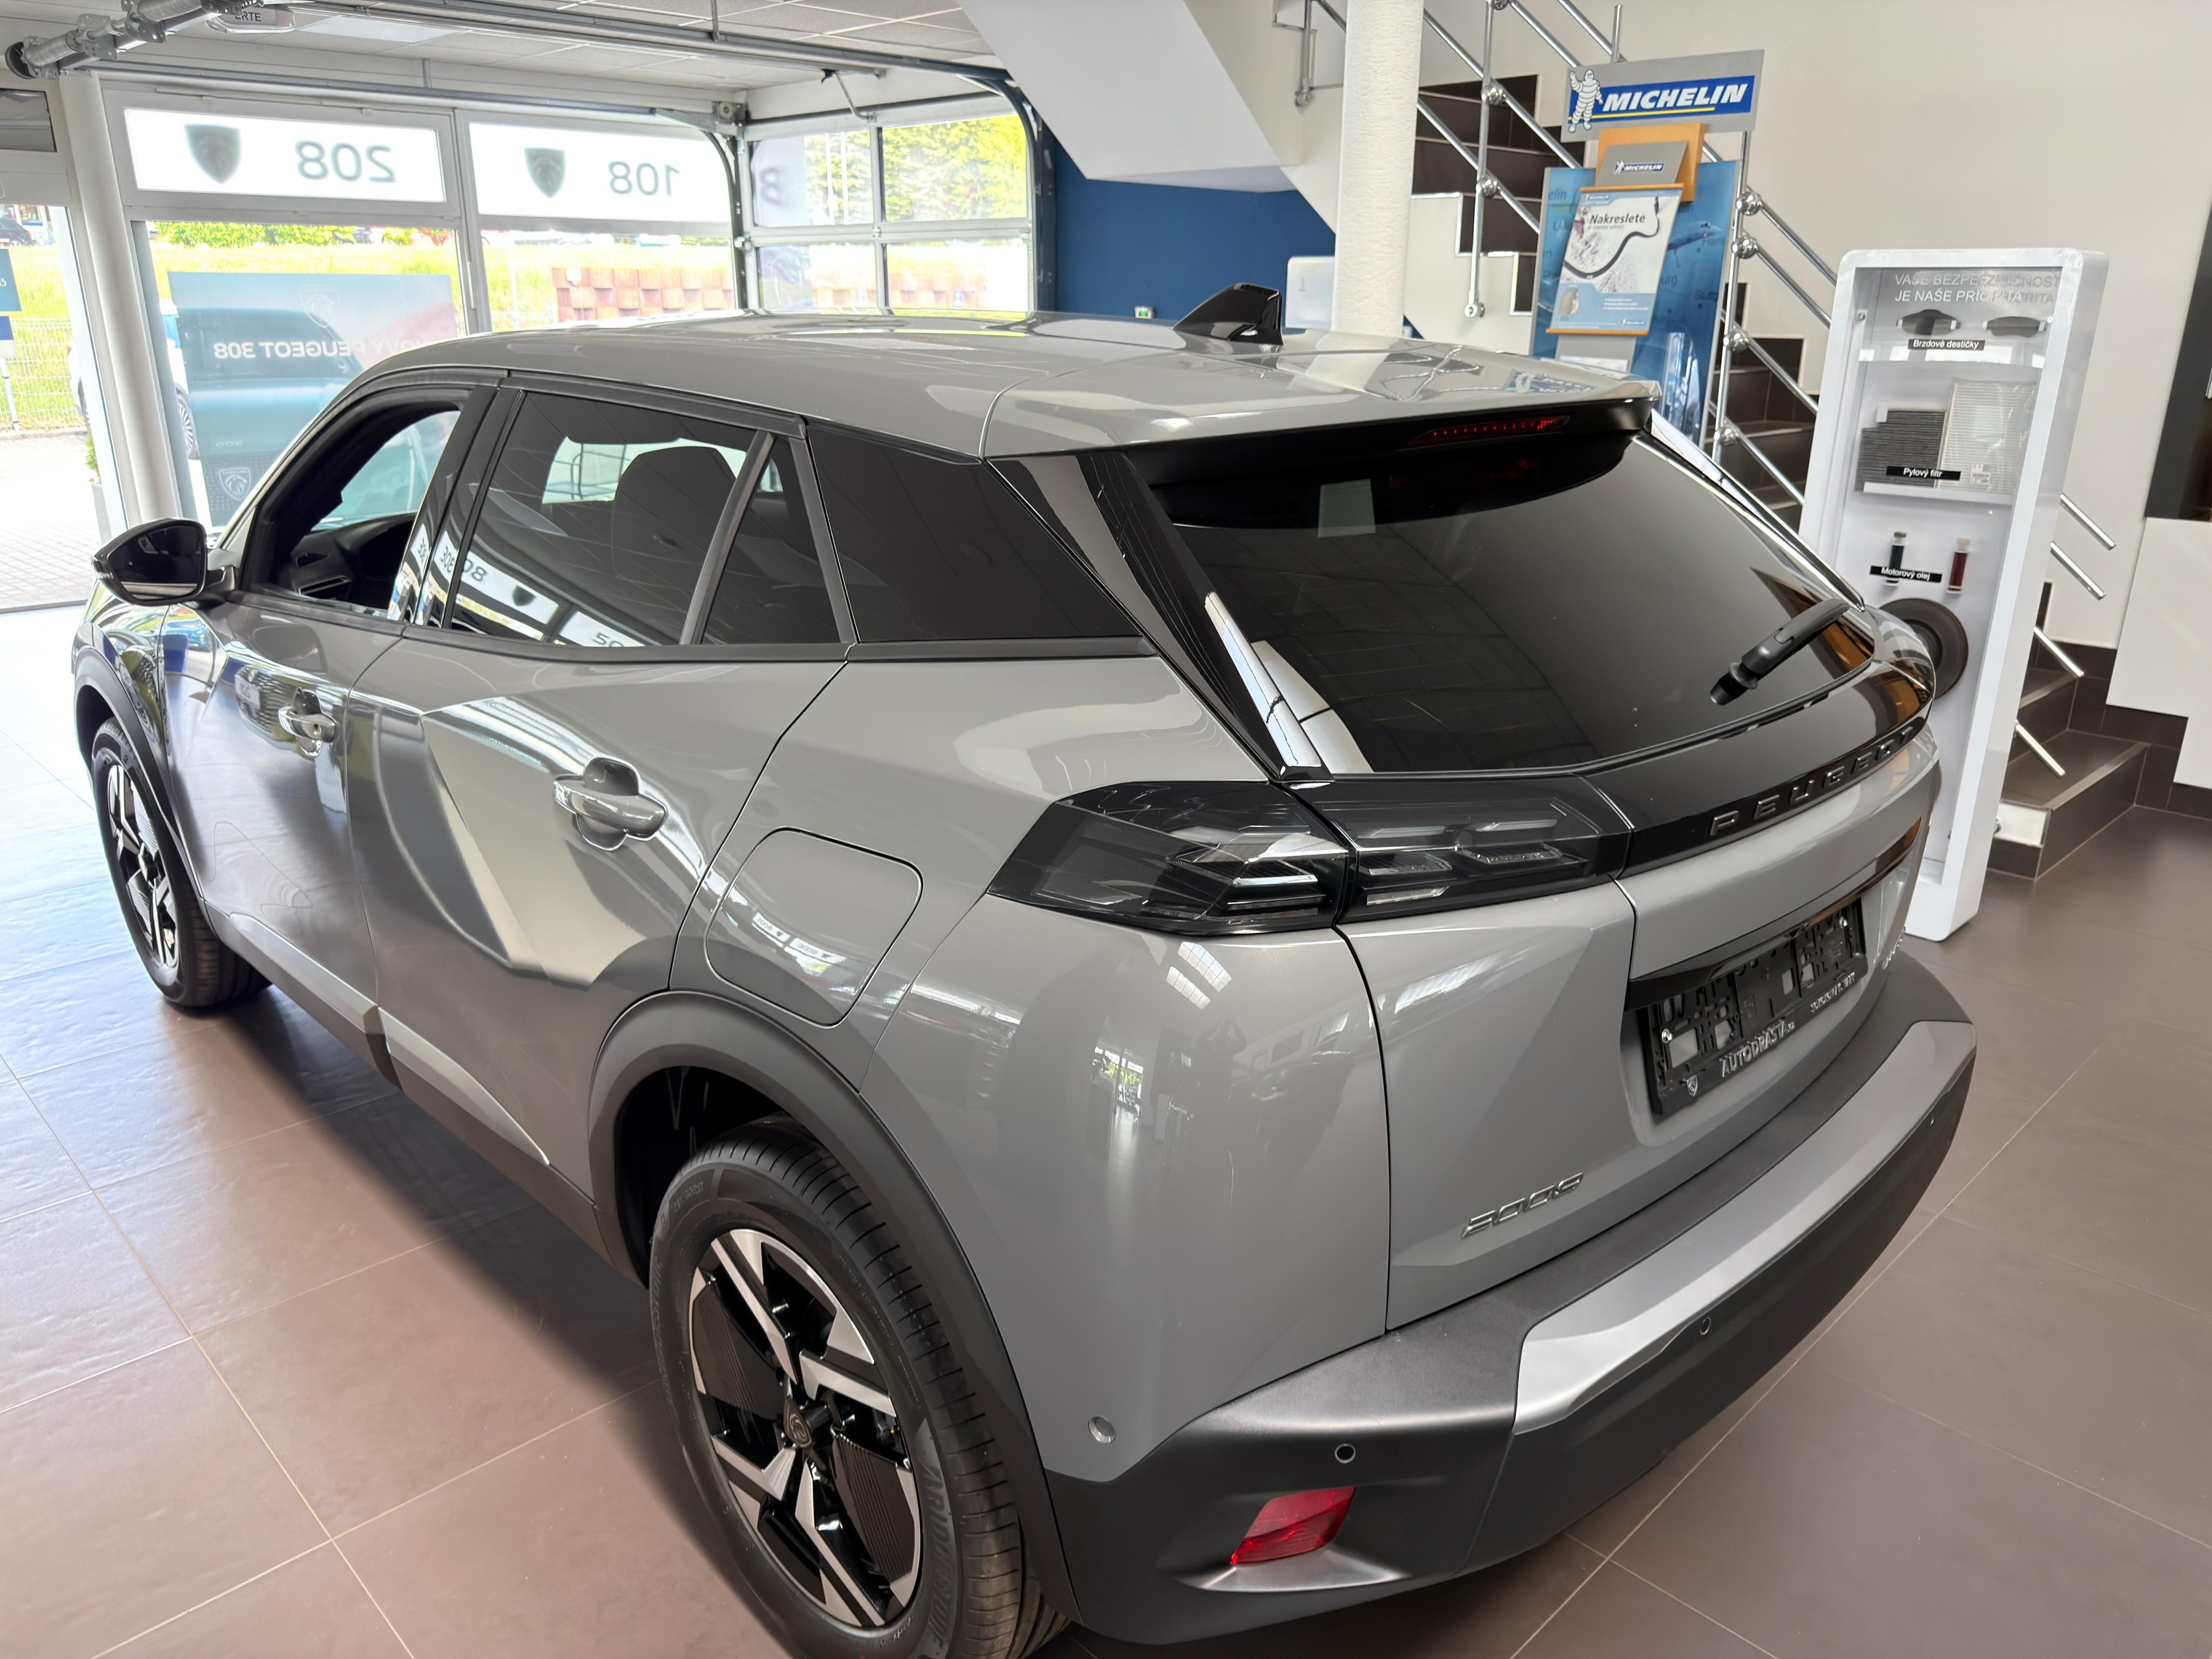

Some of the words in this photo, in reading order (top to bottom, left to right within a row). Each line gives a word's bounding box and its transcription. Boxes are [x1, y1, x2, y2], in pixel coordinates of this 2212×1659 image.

[1602, 83, 1748, 112] MICHELIN
[1589, 213, 1645, 225] Nakreslete
[1895, 290, 1911, 302] JE
[1914, 287, 1953, 302] NAŠE
[1913, 339, 1944, 348] Brzdové
[1946, 340, 1979, 349] destičky
[1903, 467, 1929, 478] Pylový
[1930, 469, 1943, 478] filtr
[1881, 567, 1915, 579] Motorový
[1917, 572, 1931, 582] olej
[1709, 726, 1913, 836] PEUGEOT
[1461, 1171, 1584, 1240] 2008
